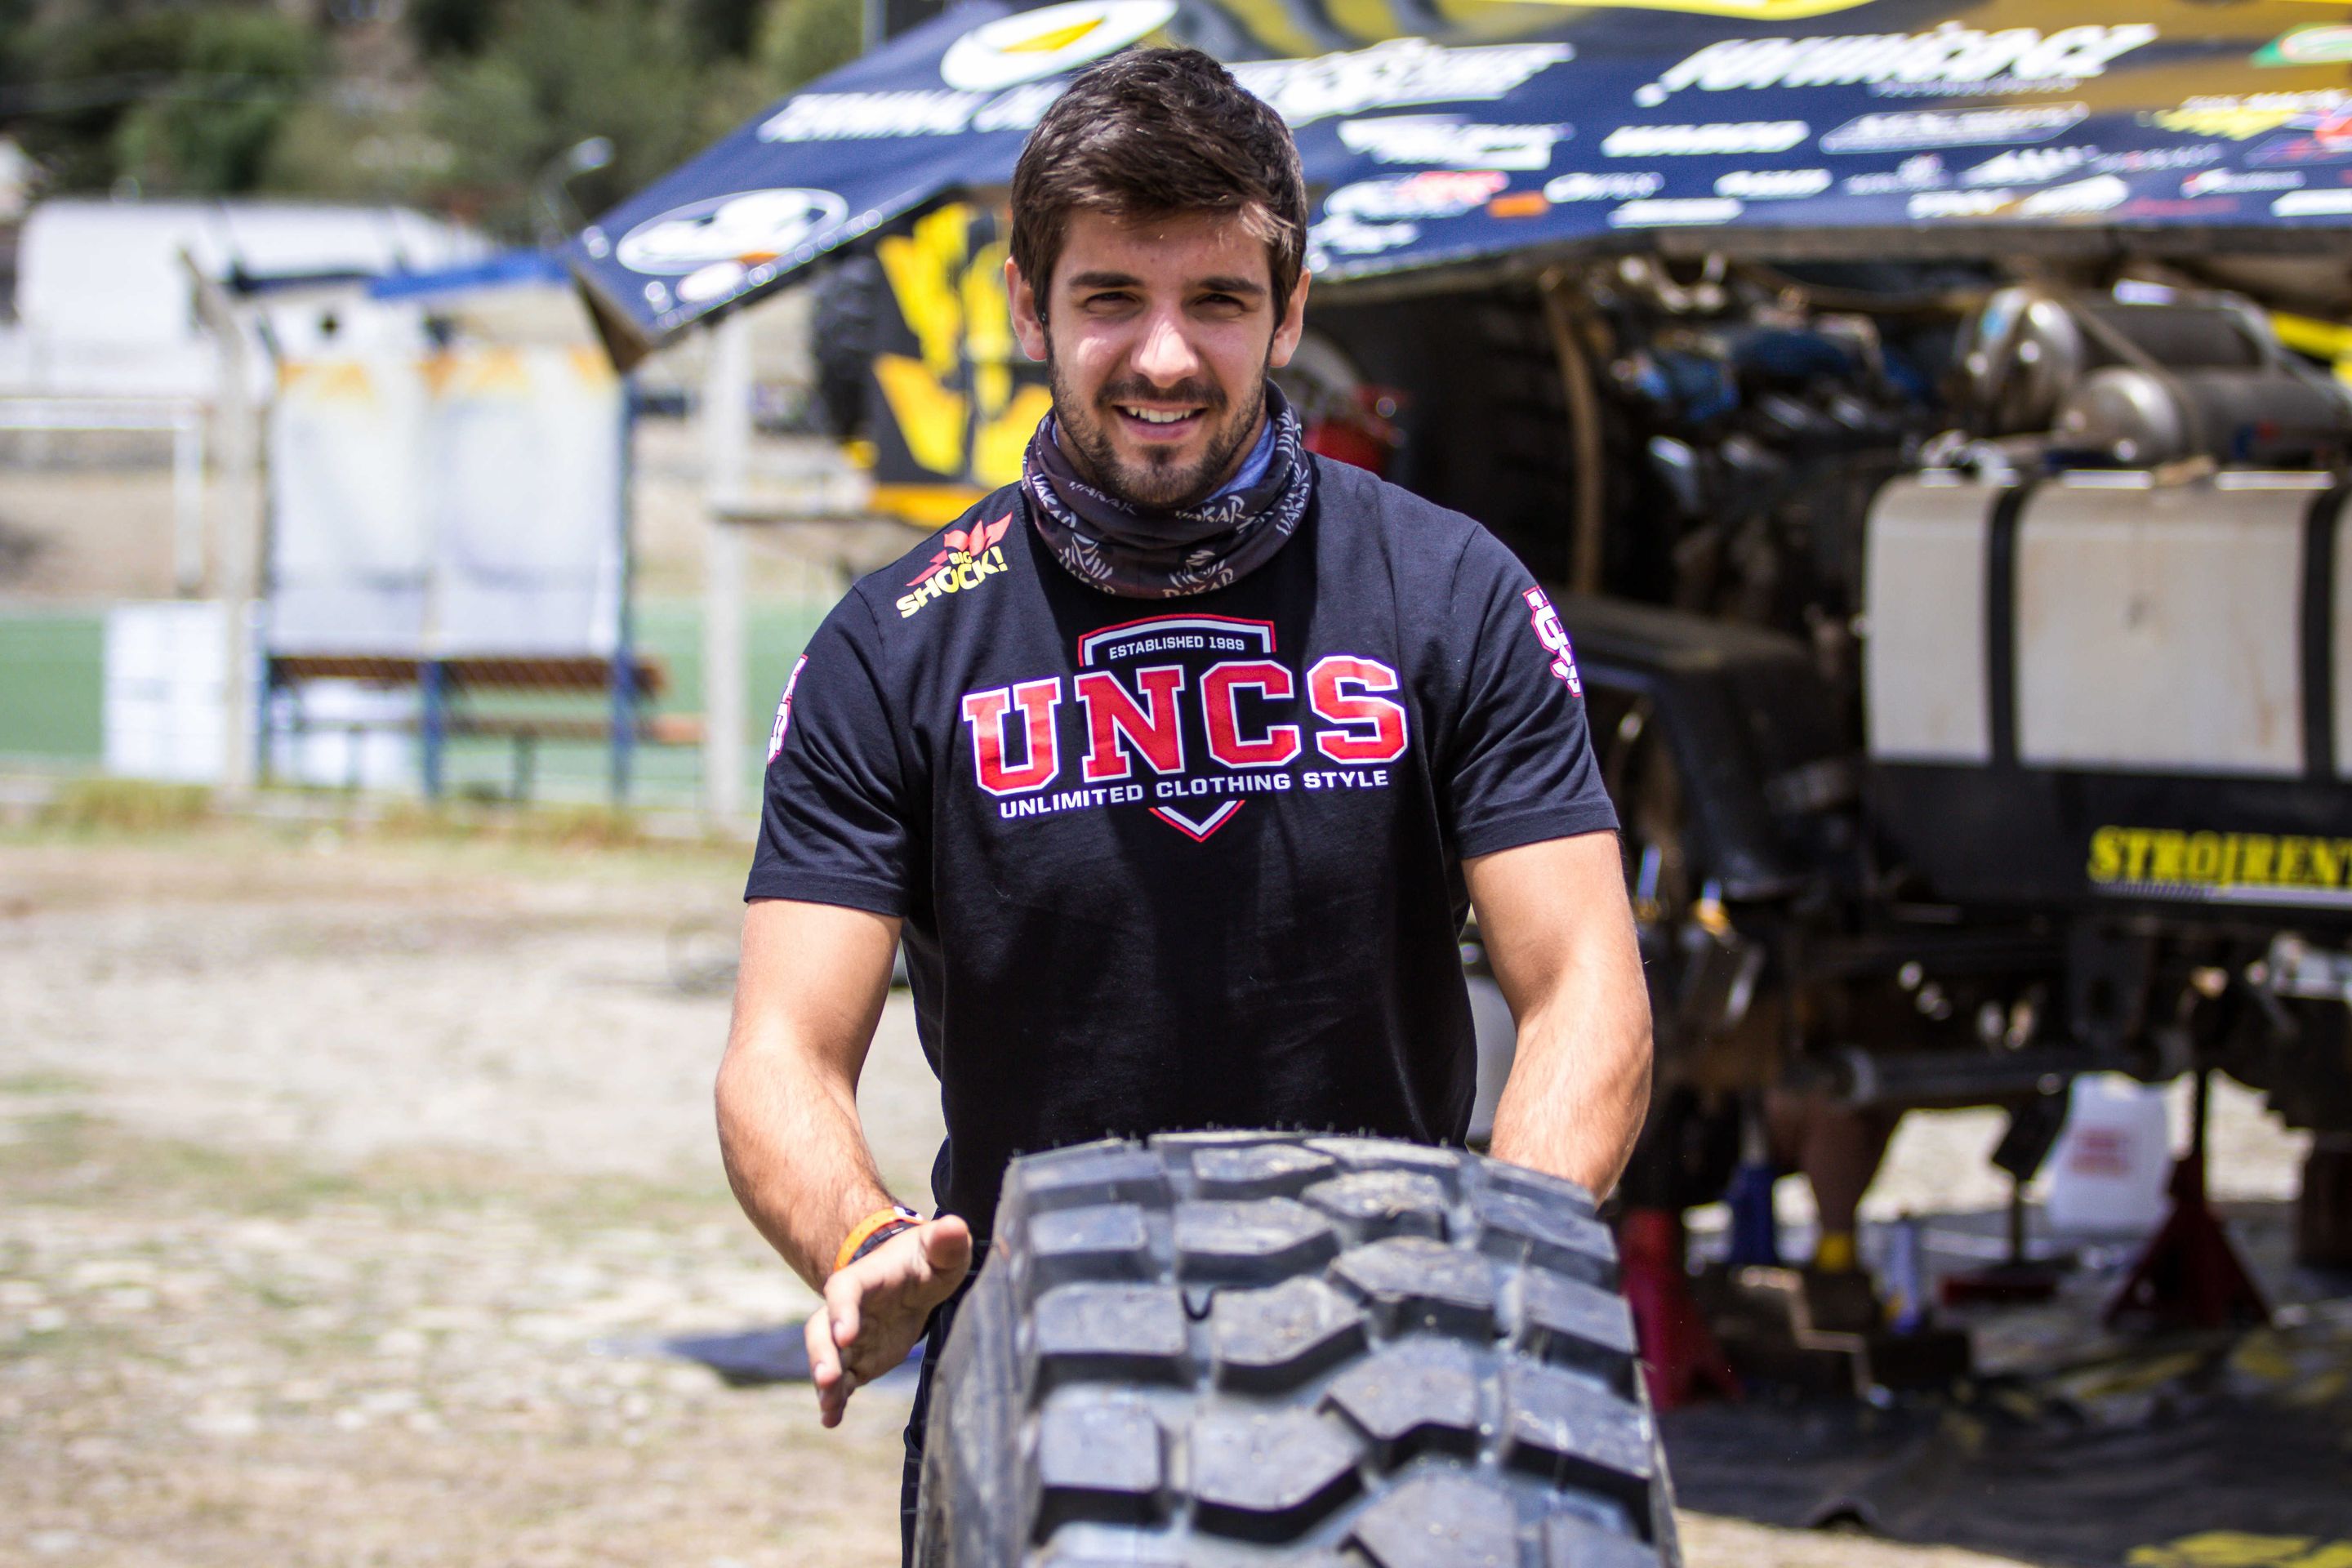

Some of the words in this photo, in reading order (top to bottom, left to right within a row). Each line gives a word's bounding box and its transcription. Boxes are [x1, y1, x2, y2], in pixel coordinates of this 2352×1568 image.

[896, 546, 1009, 618] SHOCK!
[948, 551, 973, 565] BIG
[1109, 635, 1204, 660] ESTABLISHED
[1209, 636, 1245, 651] 1989
[962, 656, 1408, 796] UNCS
[1000, 784, 1143, 818] UNLIMITED
[1156, 773, 1291, 800] CLOTHING
[1303, 770, 1388, 789] STYLE
